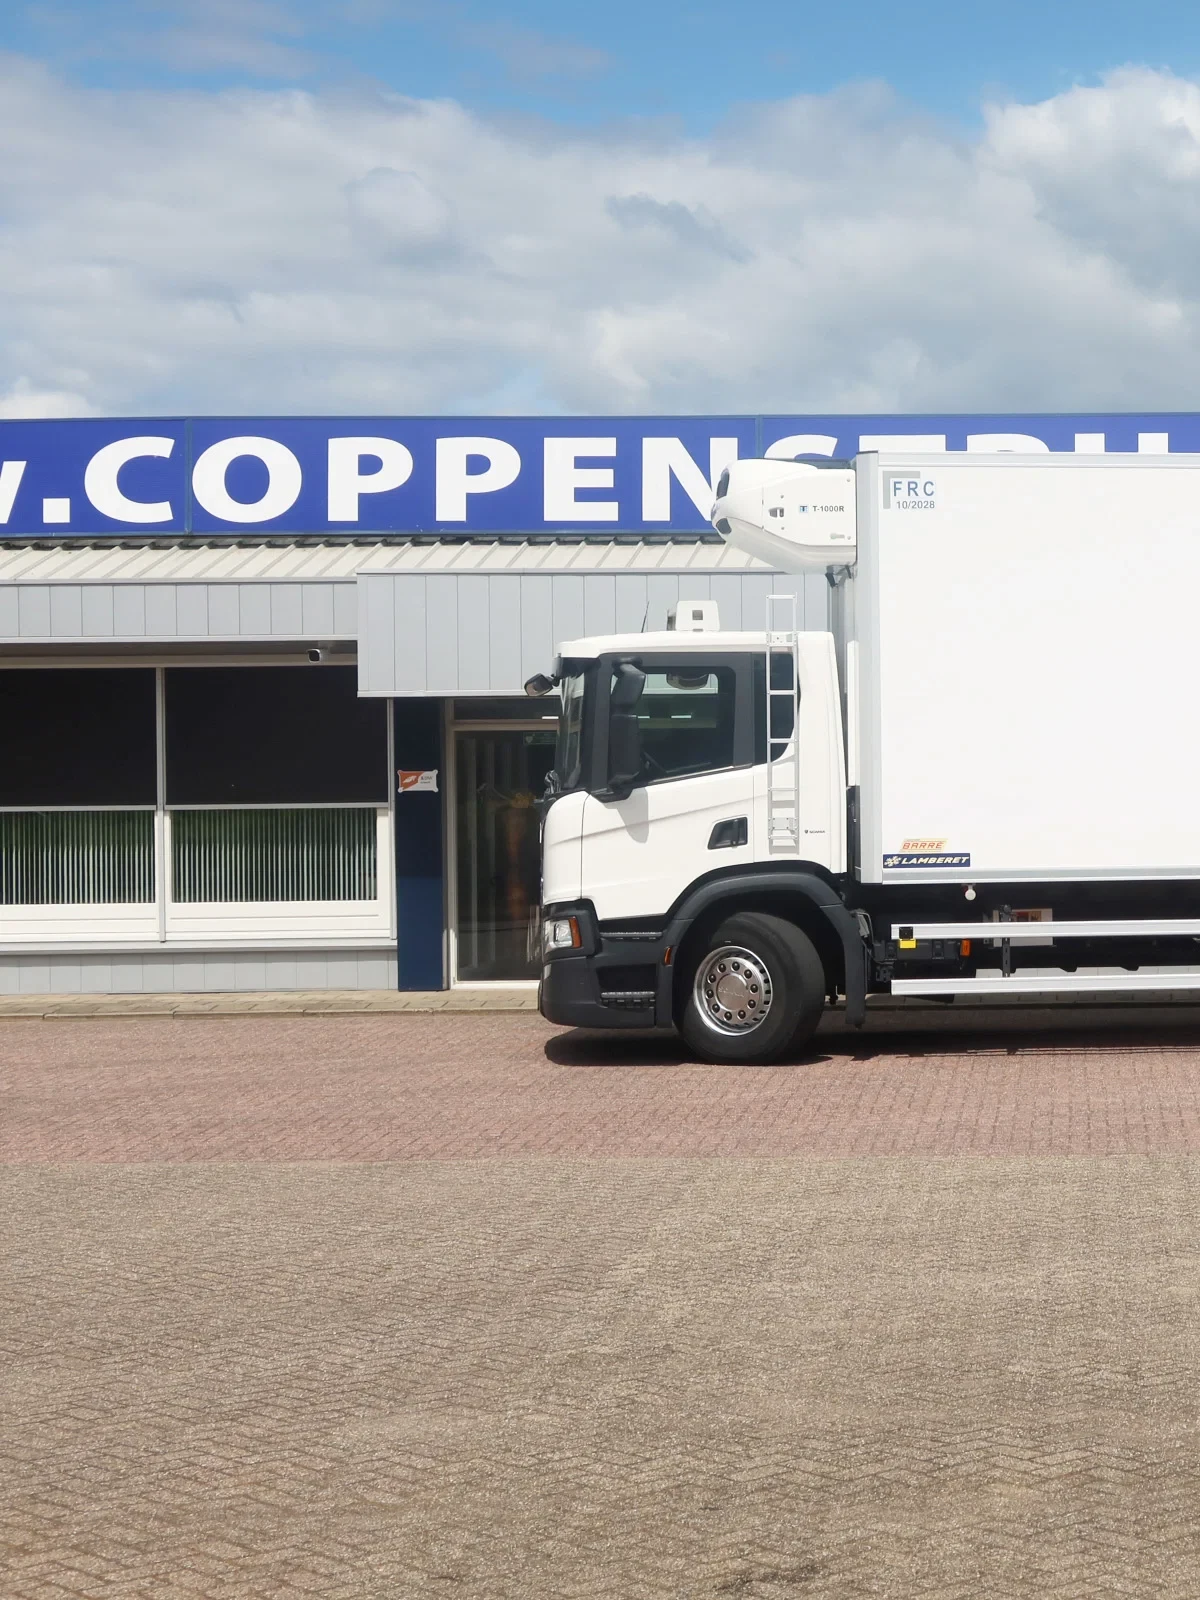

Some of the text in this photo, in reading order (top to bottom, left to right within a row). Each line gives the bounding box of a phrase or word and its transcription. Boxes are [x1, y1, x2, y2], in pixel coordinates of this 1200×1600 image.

[893, 480, 935, 497] FRC
[896, 500, 935, 509] 10/2028
[901, 856, 970, 865] LAMBERET
